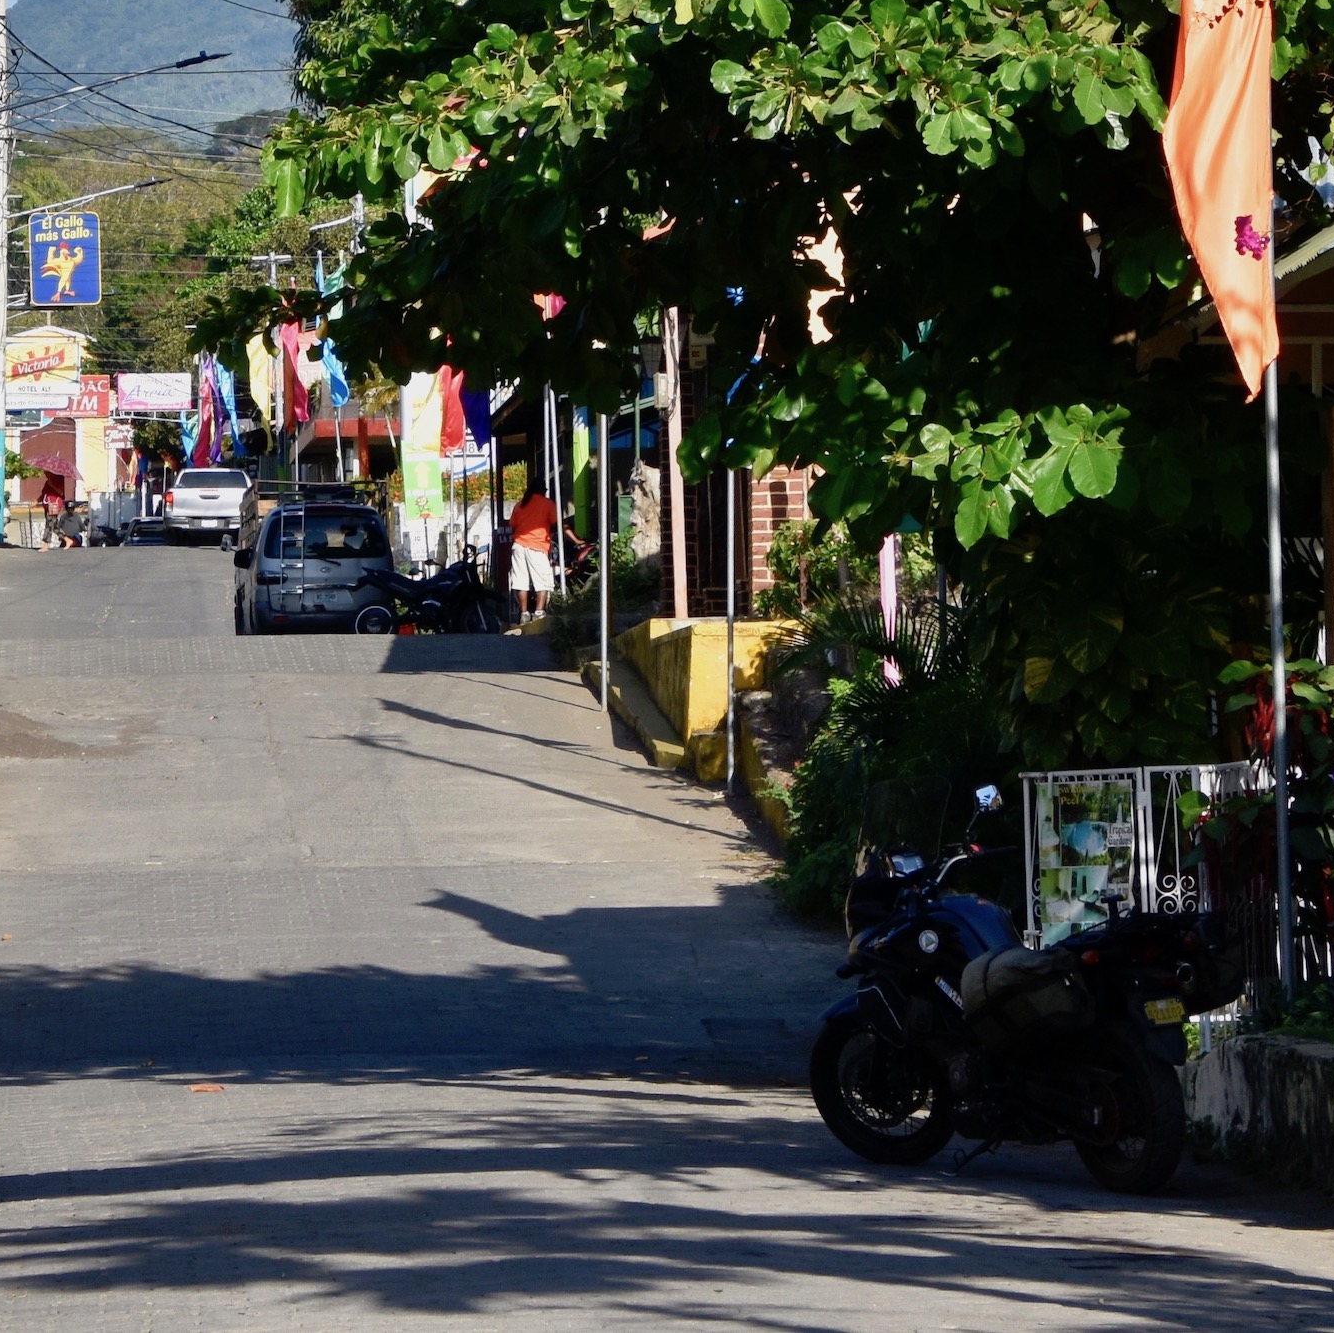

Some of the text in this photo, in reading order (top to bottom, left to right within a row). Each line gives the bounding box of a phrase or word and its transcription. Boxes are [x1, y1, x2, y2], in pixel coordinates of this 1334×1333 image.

[55, 214, 84, 229] Gallo
[35, 226, 94, 243] más Gallo.
[17, 354, 60, 376] Victoria
[80, 379, 109, 394] BAC
[69, 395, 98, 411] TM
[1108, 825, 1133, 837] Tropical
